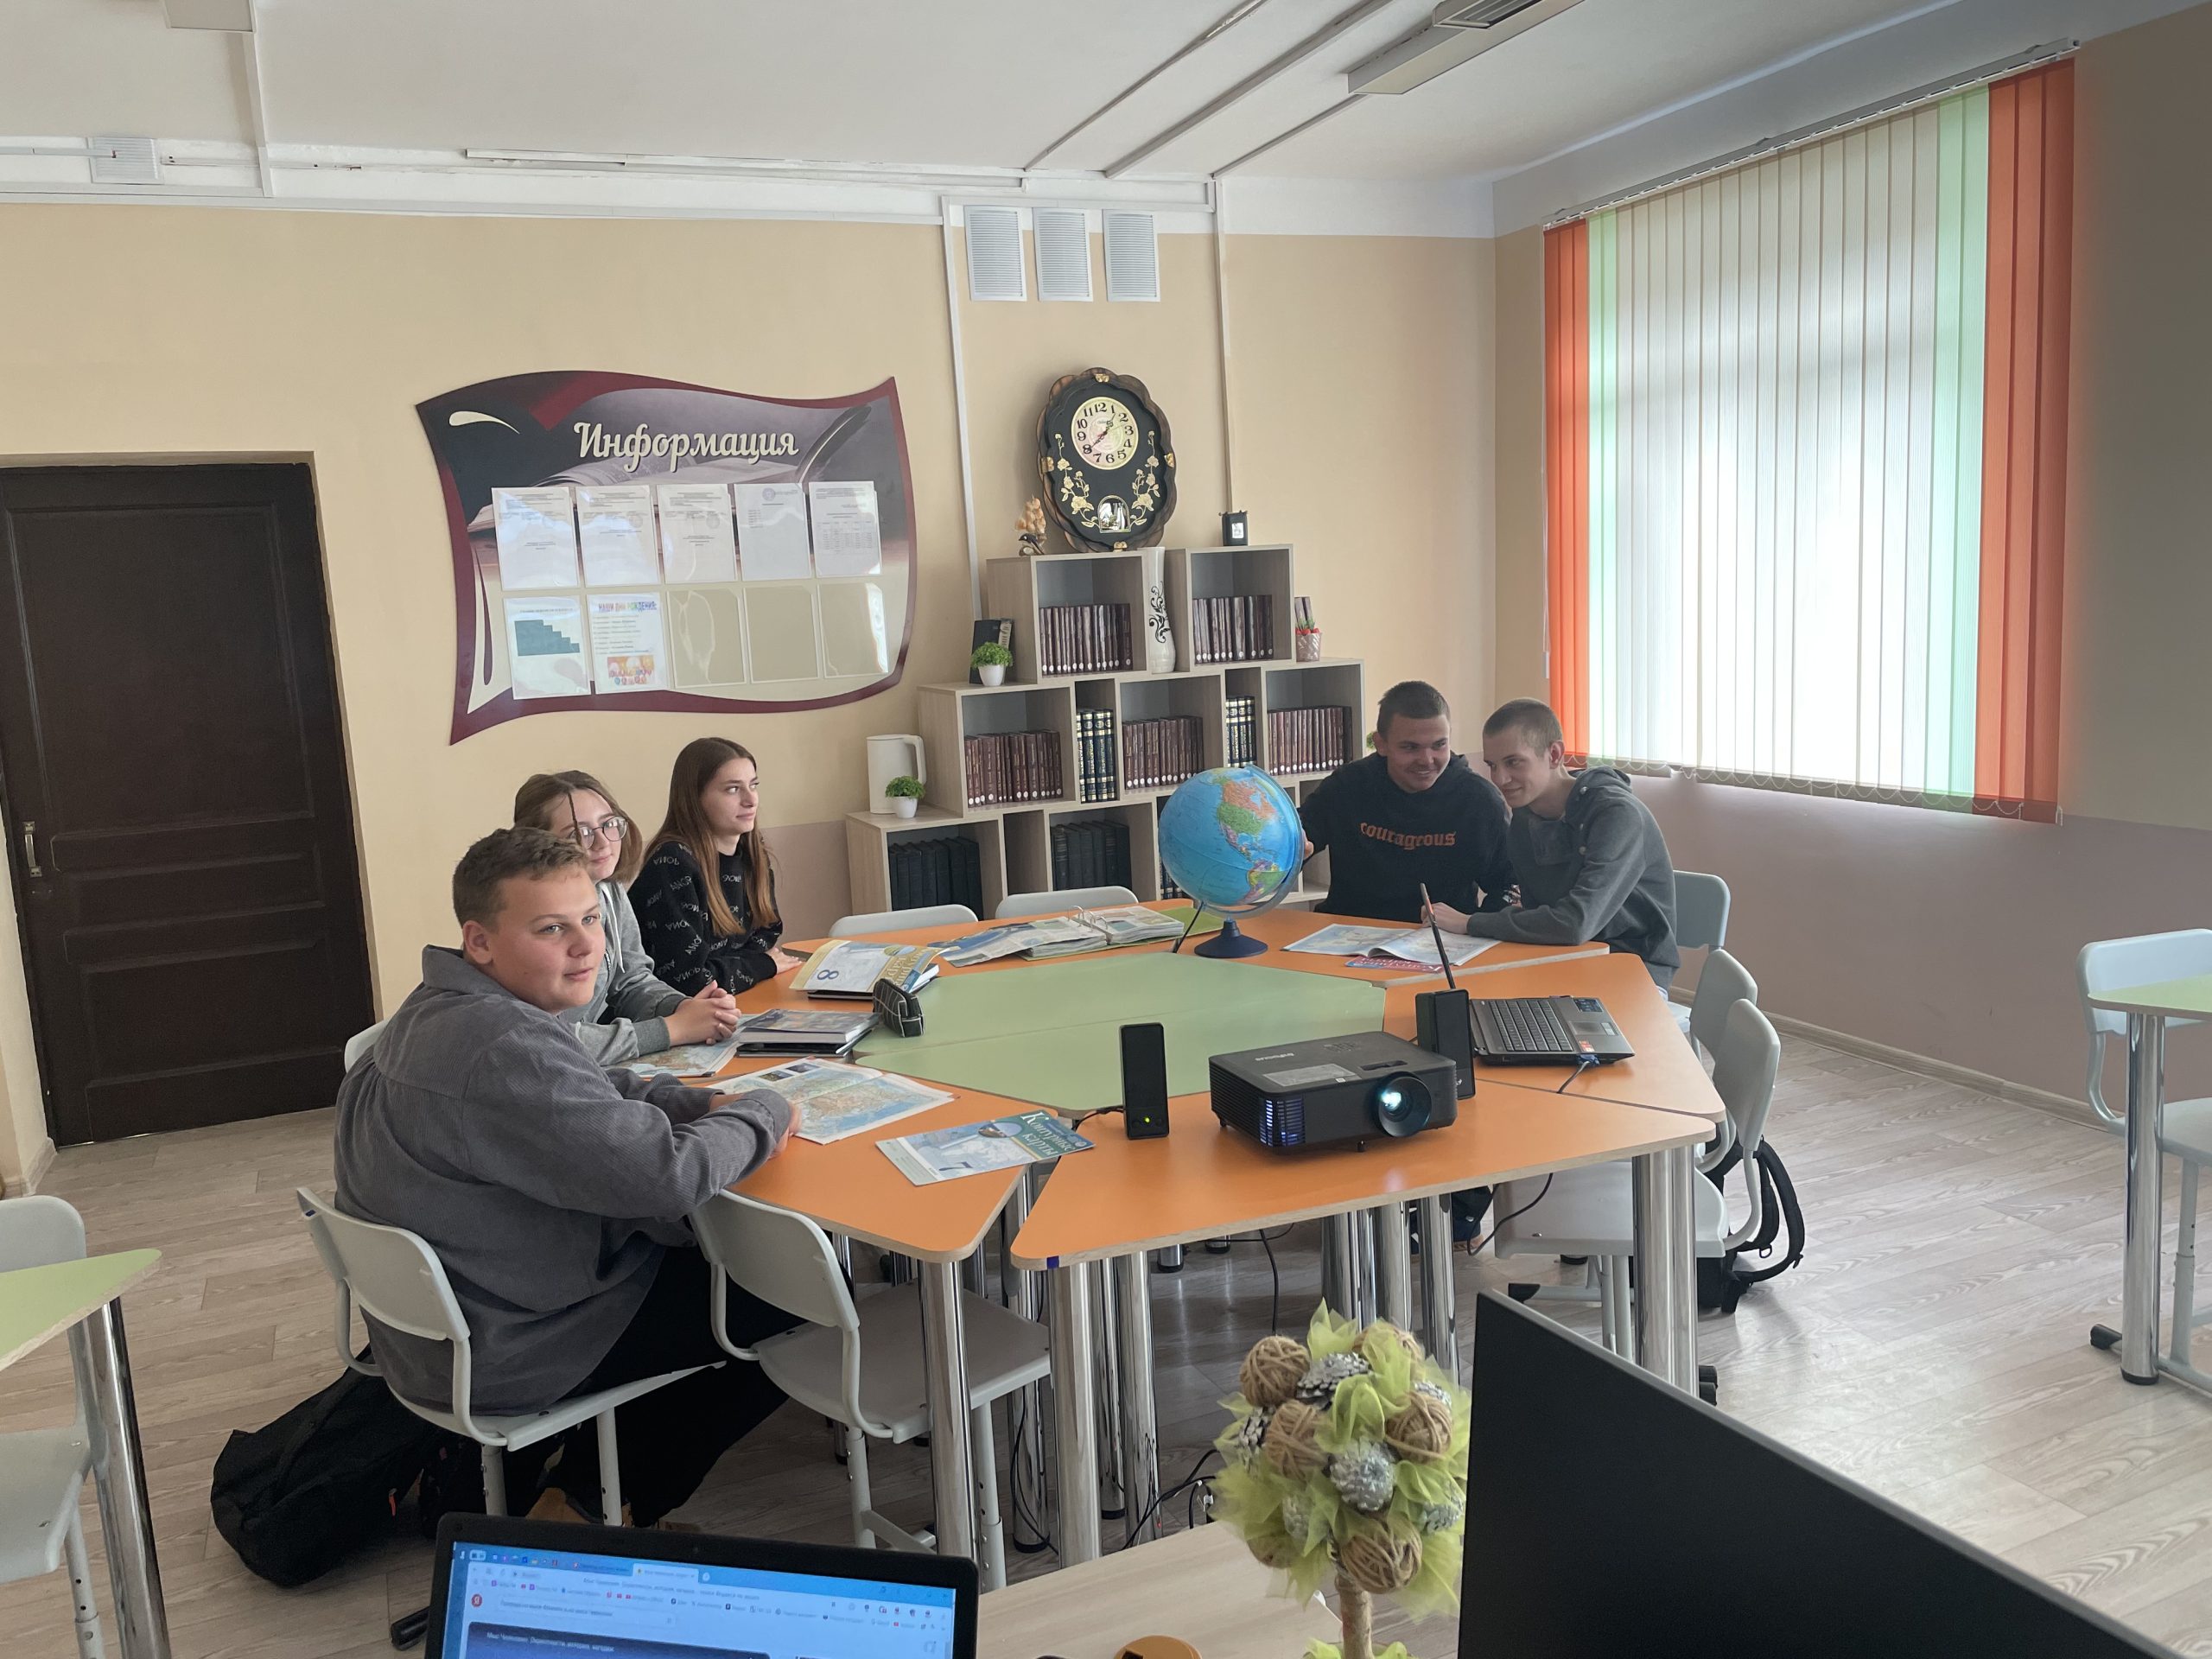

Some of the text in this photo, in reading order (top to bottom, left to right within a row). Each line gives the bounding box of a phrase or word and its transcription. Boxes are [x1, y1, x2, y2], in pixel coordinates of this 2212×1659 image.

[1084, 408, 1093, 416] 11
[1095, 403, 1107, 412] 12
[1119, 413, 1128, 422] 2
[1077, 419, 1087, 429] 10
[1124, 425, 1134, 435] 3
[1077, 431, 1086, 441] 9
[574, 422, 799, 473] Информация
[1123, 439, 1132, 448] 4
[1083, 444, 1092, 454] 8
[1117, 449, 1127, 459] 5
[1093, 454, 1102, 462] 7
[1106, 454, 1115, 463] 6
[817, 969, 839, 981] 8
